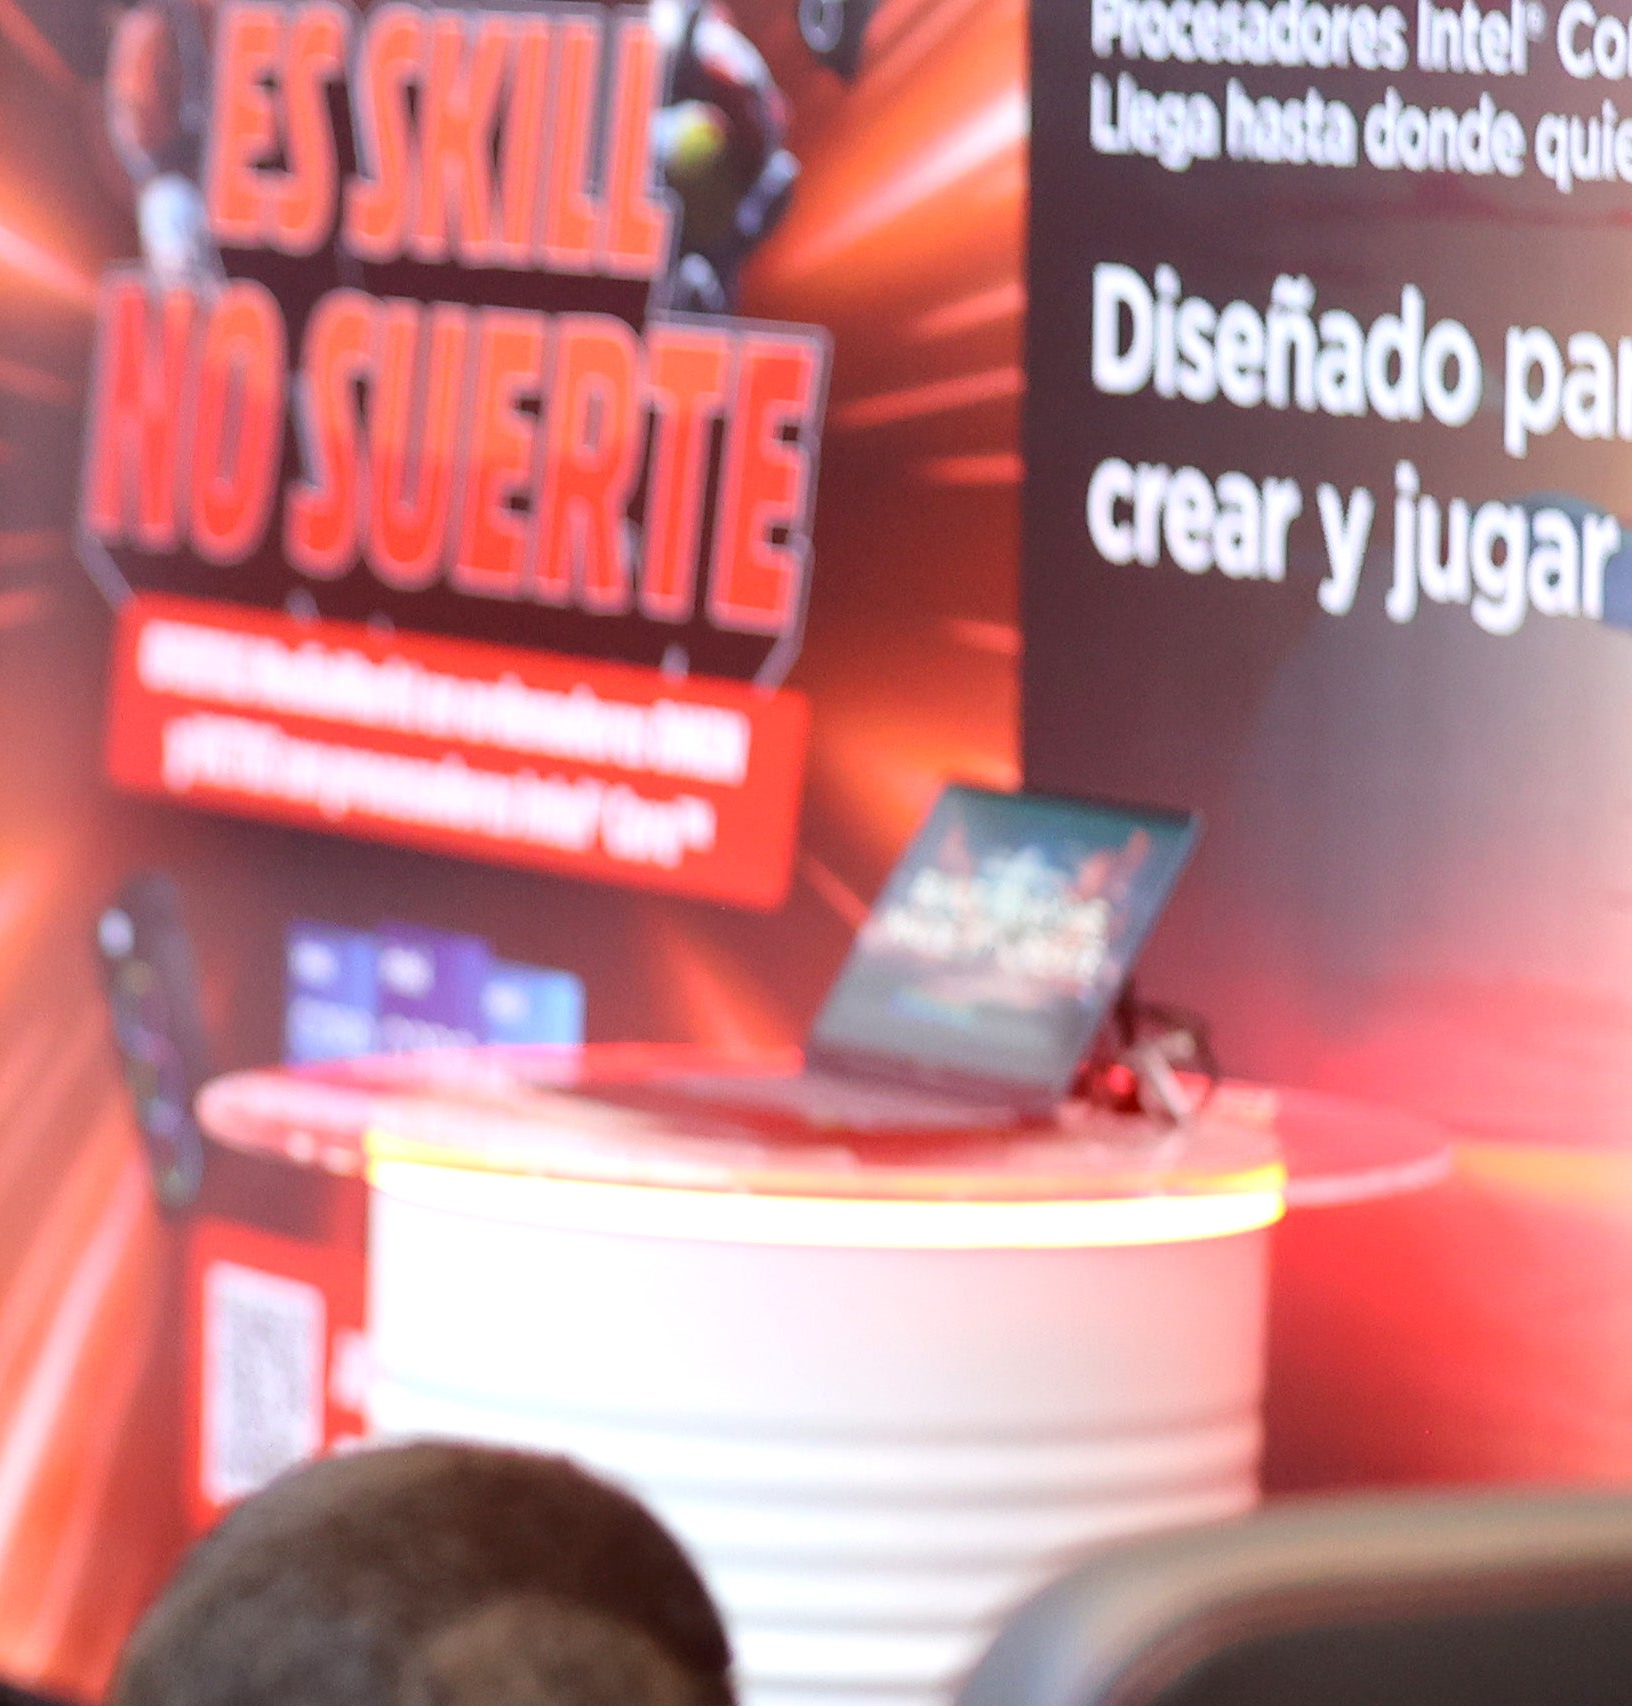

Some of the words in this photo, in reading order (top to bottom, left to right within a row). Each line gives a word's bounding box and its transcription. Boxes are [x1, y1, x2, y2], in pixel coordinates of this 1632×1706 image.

[1089, 70, 1222, 172] Llega
[1225, 76, 1359, 168] hasta
[1363, 85, 1527, 178] donde
[1090, 0, 1408, 71] Procesadores
[1556, 0, 1632, 80] Co
[206, 6, 343, 257] ES
[344, 10, 671, 277] SKILL
[1091, 260, 1485, 427] Diseñado
[83, 277, 284, 563] NO
[285, 288, 819, 640] SUERTE
[1087, 457, 1301, 582] crear
[1316, 483, 1375, 615] y
[1385, 459, 1621, 636] jugar
